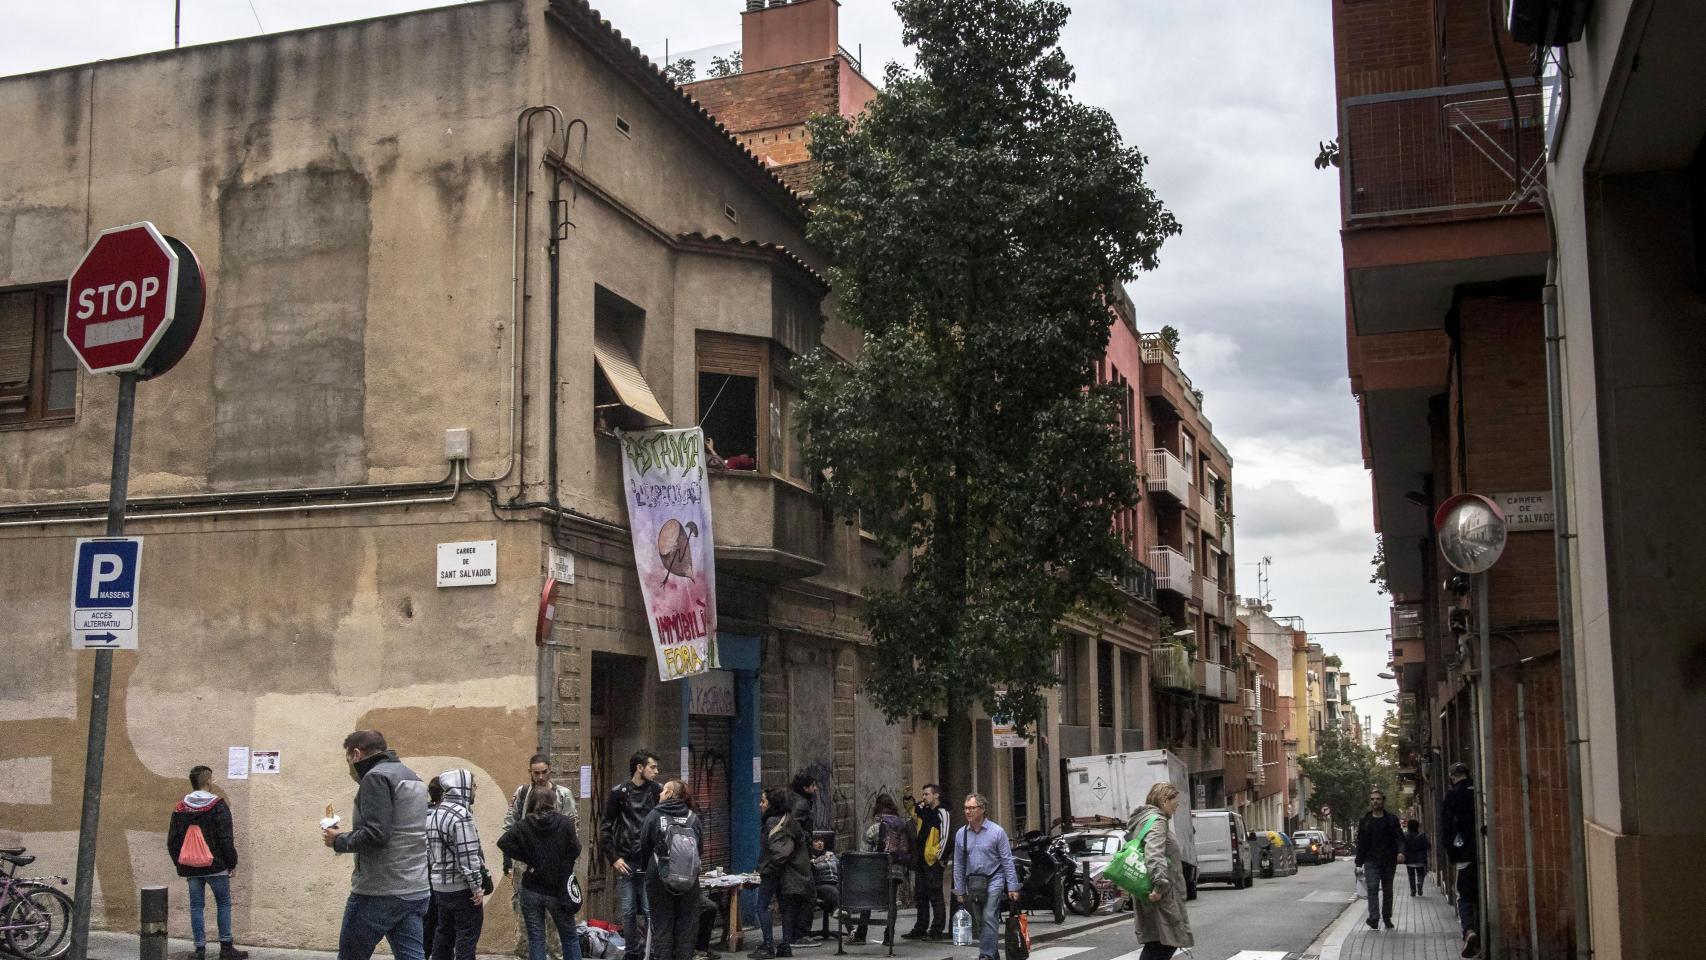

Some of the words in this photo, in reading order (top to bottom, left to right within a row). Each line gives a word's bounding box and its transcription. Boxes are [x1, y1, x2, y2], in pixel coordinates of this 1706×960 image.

[76, 277, 160, 319] STOP
[1506, 496, 1542, 504] CARRER
[1517, 512, 1554, 523] SALVADO
[89, 553, 123, 599] P
[440, 570, 456, 579] SANT
[459, 568, 491, 578] SALVADOR
[99, 591, 130, 599] MASSENS
[91, 611, 112, 619] ACCÉS
[83, 620, 120, 628] ALTERNATIU
[664, 646, 703, 677] FORA
